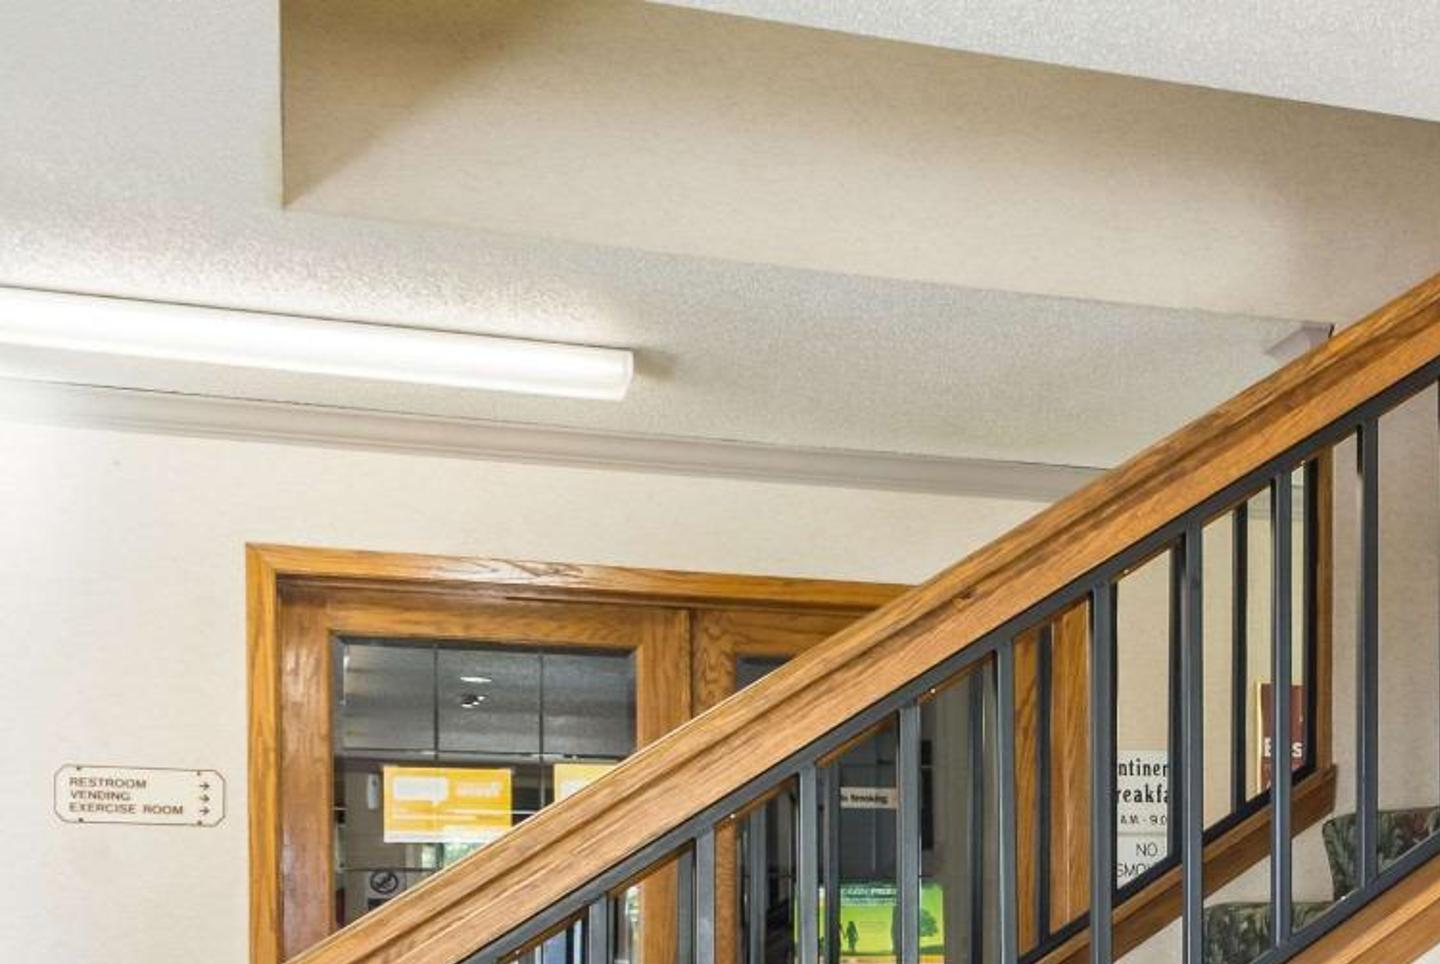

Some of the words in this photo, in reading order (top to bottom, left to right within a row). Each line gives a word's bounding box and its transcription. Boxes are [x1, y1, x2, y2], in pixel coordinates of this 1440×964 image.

[69, 777, 147, 789] RESTROOM
[70, 790, 131, 801] VENDING
[69, 803, 136, 814] EXERCISE
[143, 805, 183, 815] ROOM
[1136, 842, 1159, 858] NO
